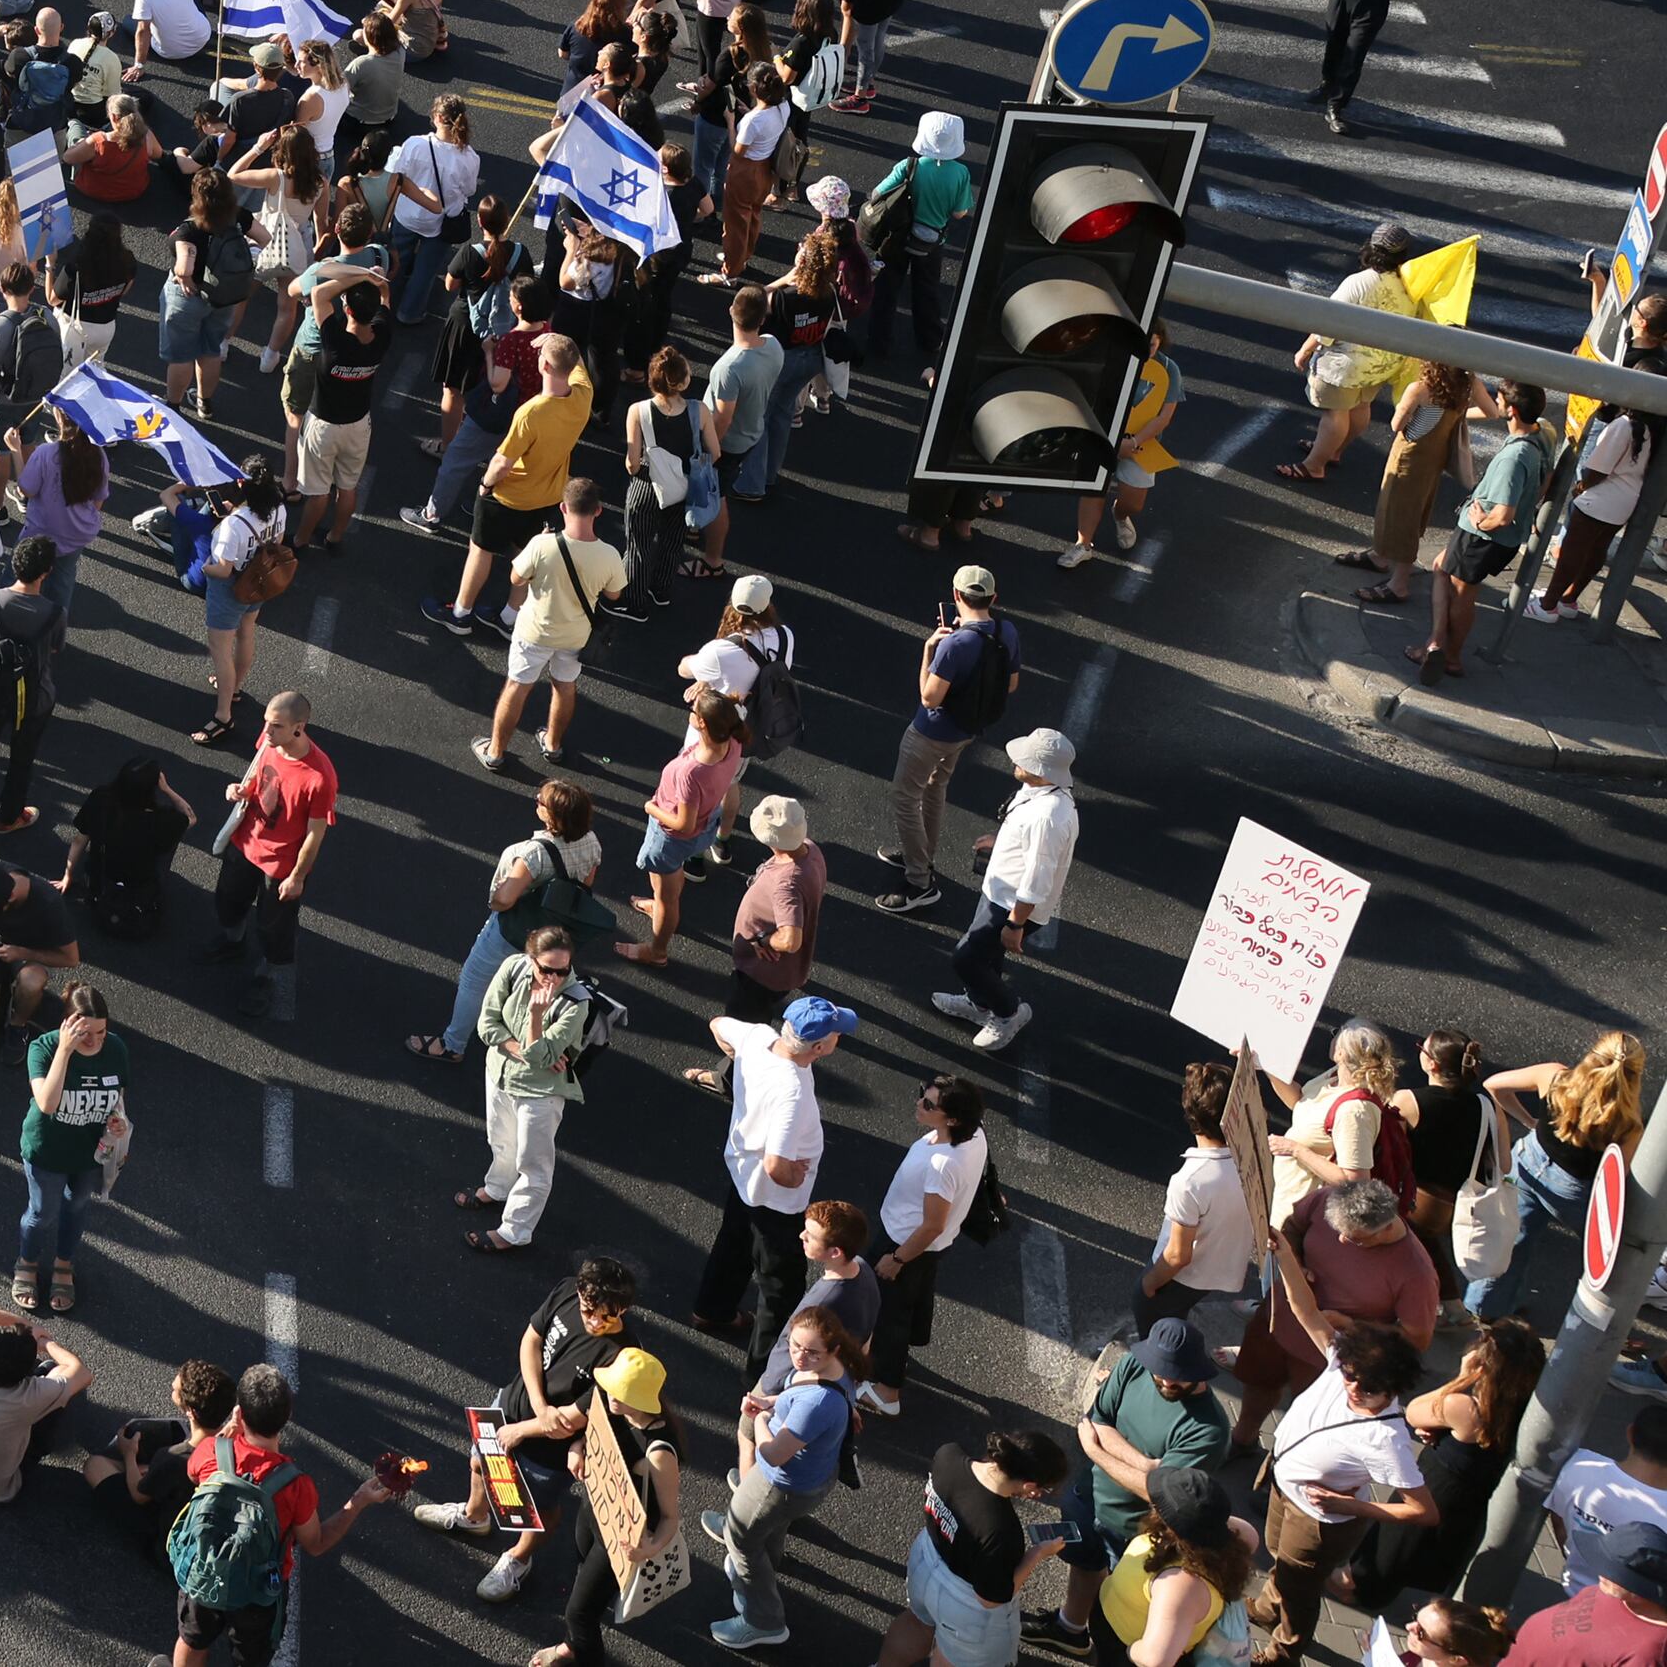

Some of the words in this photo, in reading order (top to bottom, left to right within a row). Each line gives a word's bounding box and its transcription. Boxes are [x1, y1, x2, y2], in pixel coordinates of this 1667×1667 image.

[1264, 854, 1361, 900] ממשלת
[1234, 881, 1271, 907] יעזרו
[1274, 907, 1307, 924] לא
[1258, 915, 1287, 943] כסף
[1300, 925, 1339, 949] כבר
[1203, 939, 1244, 961] לכם
[1242, 937, 1283, 966] כיפור
[1243, 959, 1294, 990] מחכה
[1290, 969, 1317, 985] יום
[1266, 994, 1305, 1022] בשער
[58, 1089, 120, 1114] NEVER
[56, 1111, 109, 1126] SURRENDE
